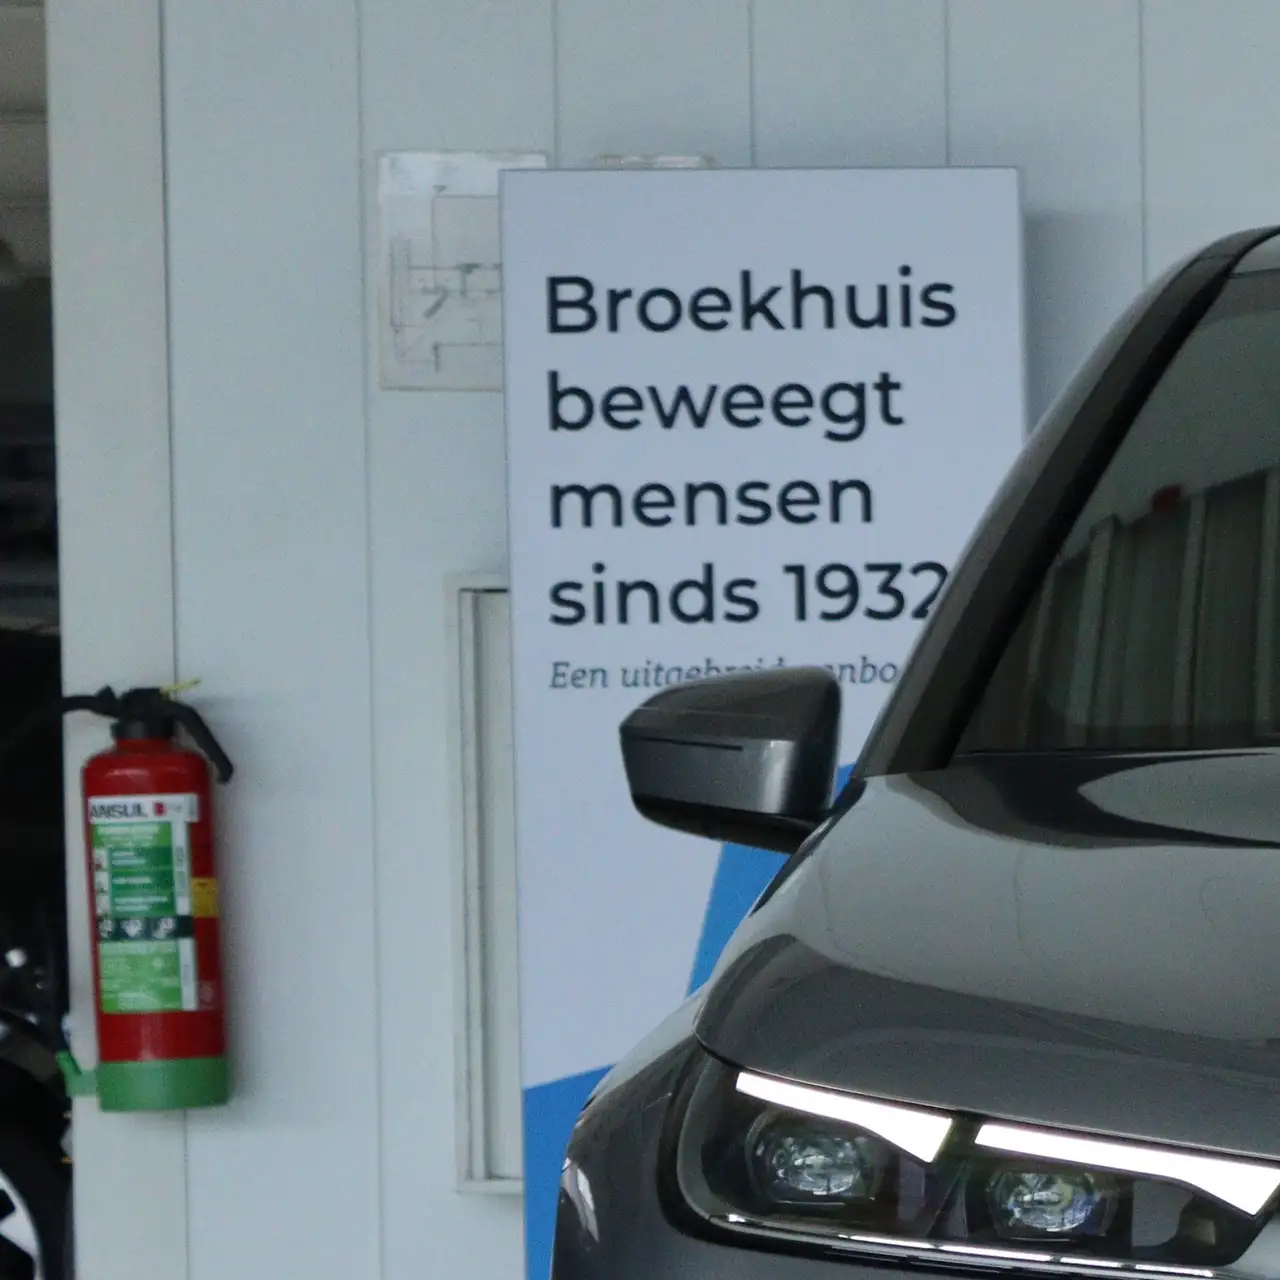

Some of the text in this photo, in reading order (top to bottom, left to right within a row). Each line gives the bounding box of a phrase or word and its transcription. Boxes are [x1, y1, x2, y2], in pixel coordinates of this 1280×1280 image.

[545, 263, 958, 334] Broekhuis
[546, 370, 905, 443] beweegt
[549, 478, 874, 529] mensen
[548, 560, 949, 626] sinds 1932
[550, 661, 608, 689] Een
